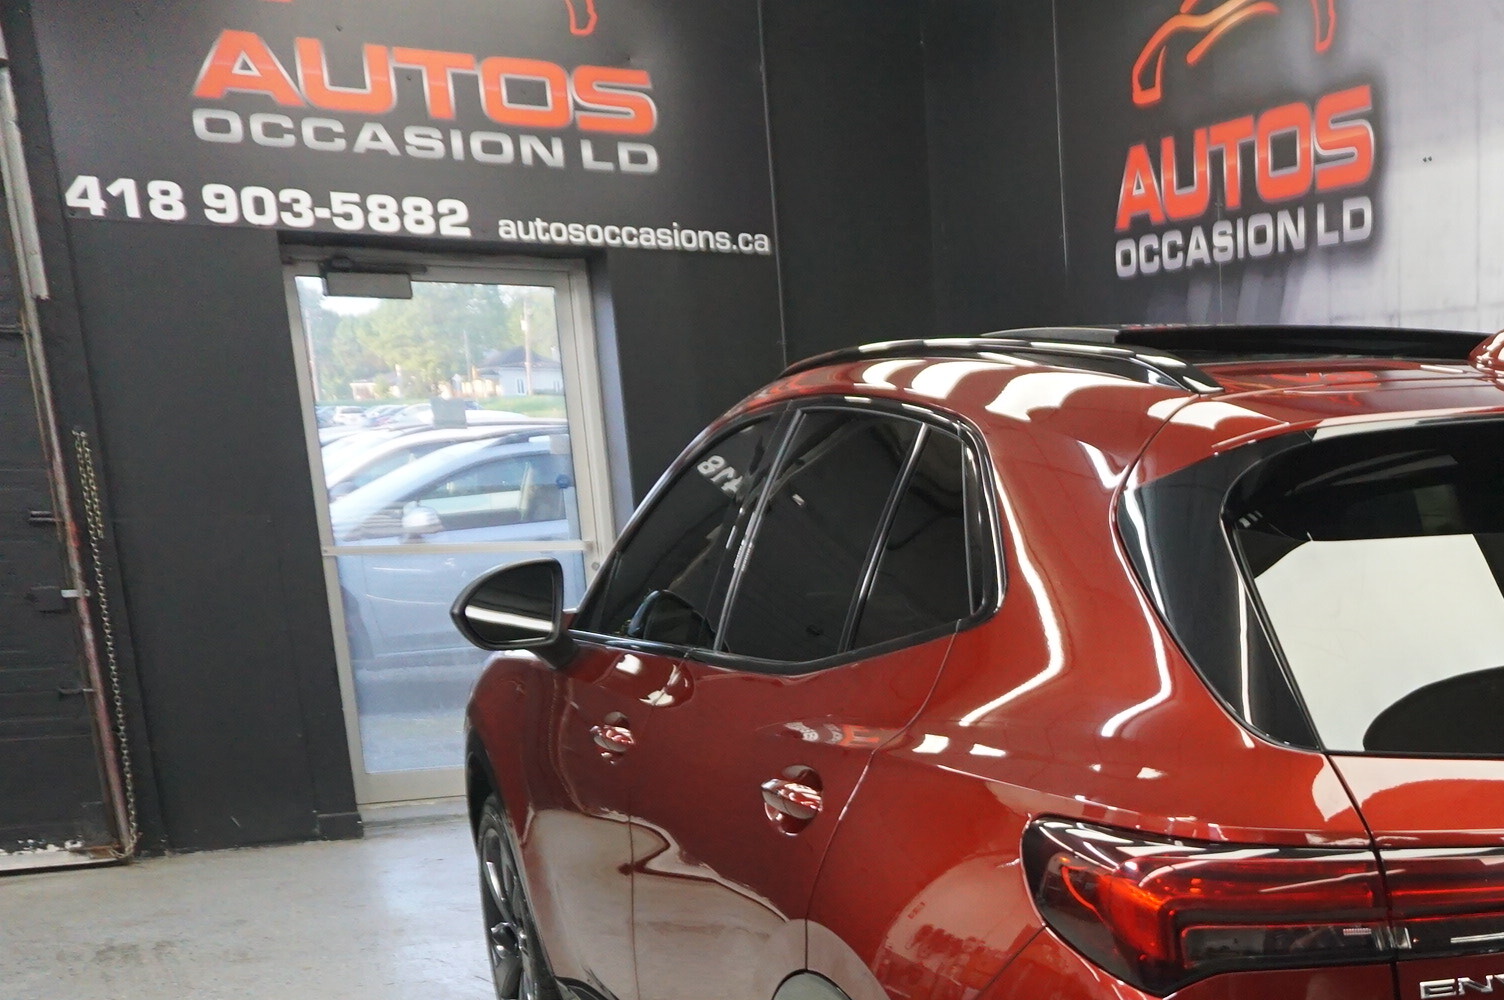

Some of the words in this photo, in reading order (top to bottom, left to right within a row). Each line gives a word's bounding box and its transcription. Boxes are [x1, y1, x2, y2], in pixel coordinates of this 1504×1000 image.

[193, 29, 658, 135] AUTOS
[192, 108, 564, 168] OCCASION
[580, 138, 659, 173] LD
[1114, 84, 1375, 232] AUTOS
[65, 175, 187, 222] 418
[201, 183, 472, 238] 903-5882
[498, 217, 771, 255] autosoccasions.ca
[1115, 206, 1305, 279] OCCASION
[1317, 196, 1373, 247] LD
